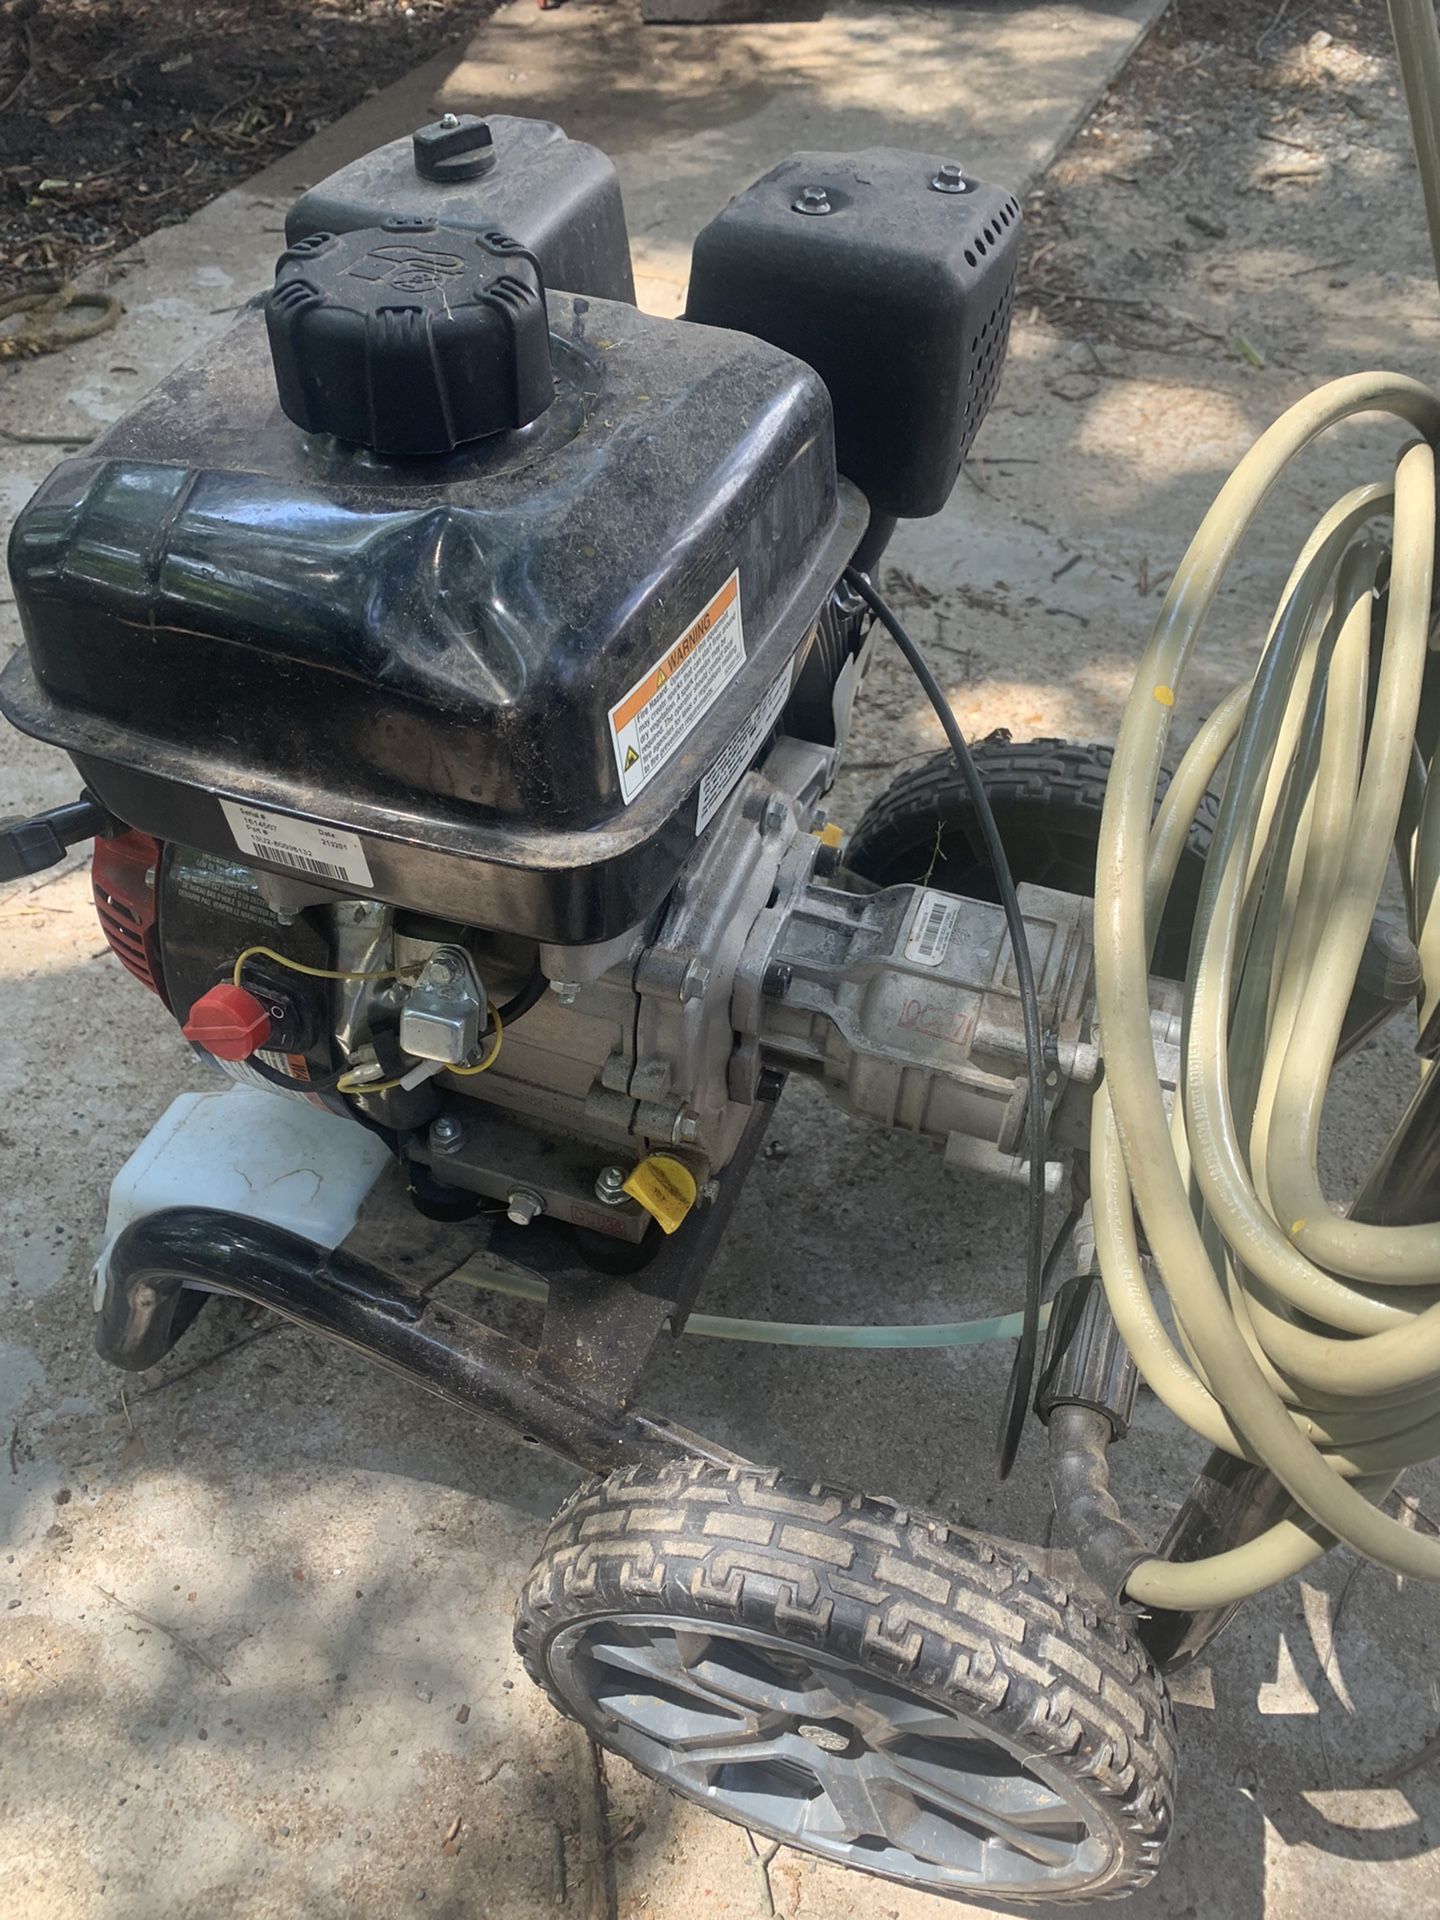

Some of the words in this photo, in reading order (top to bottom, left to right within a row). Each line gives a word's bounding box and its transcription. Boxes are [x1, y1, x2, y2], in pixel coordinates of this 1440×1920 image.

[667, 612, 711, 673] WARNING
[638, 716, 650, 735] may
[650, 696, 666, 721] create
[666, 677, 683, 702] sparks
[682, 664, 693, 682] that
[636, 704, 648, 723] Fire
[664, 711, 673, 728] The
[639, 729, 649, 746] dry
